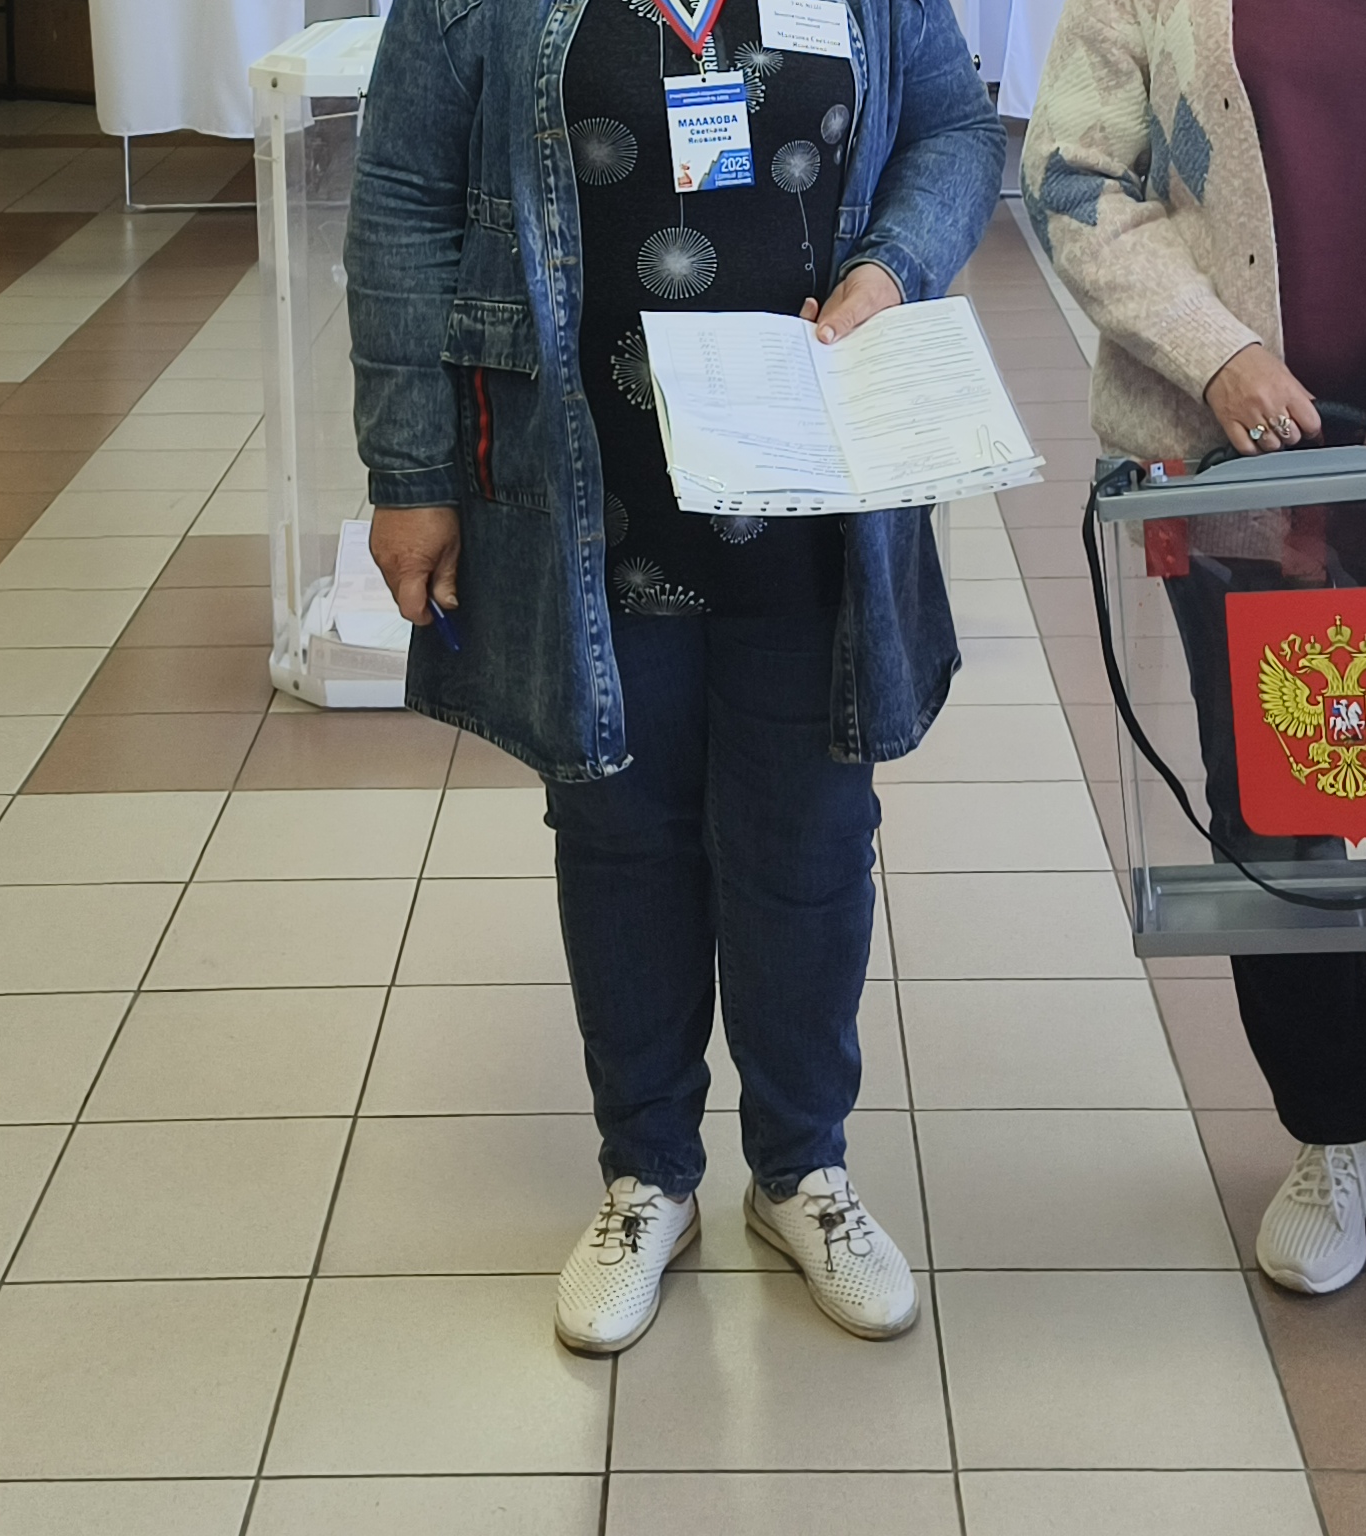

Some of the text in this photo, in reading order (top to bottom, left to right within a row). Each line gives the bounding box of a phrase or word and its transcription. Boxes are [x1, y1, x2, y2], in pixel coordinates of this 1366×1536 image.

[701, 31, 719, 71] RIGIN
[678, 114, 738, 128] МАЛАХОВА
[720, 156, 751, 173] 2025
